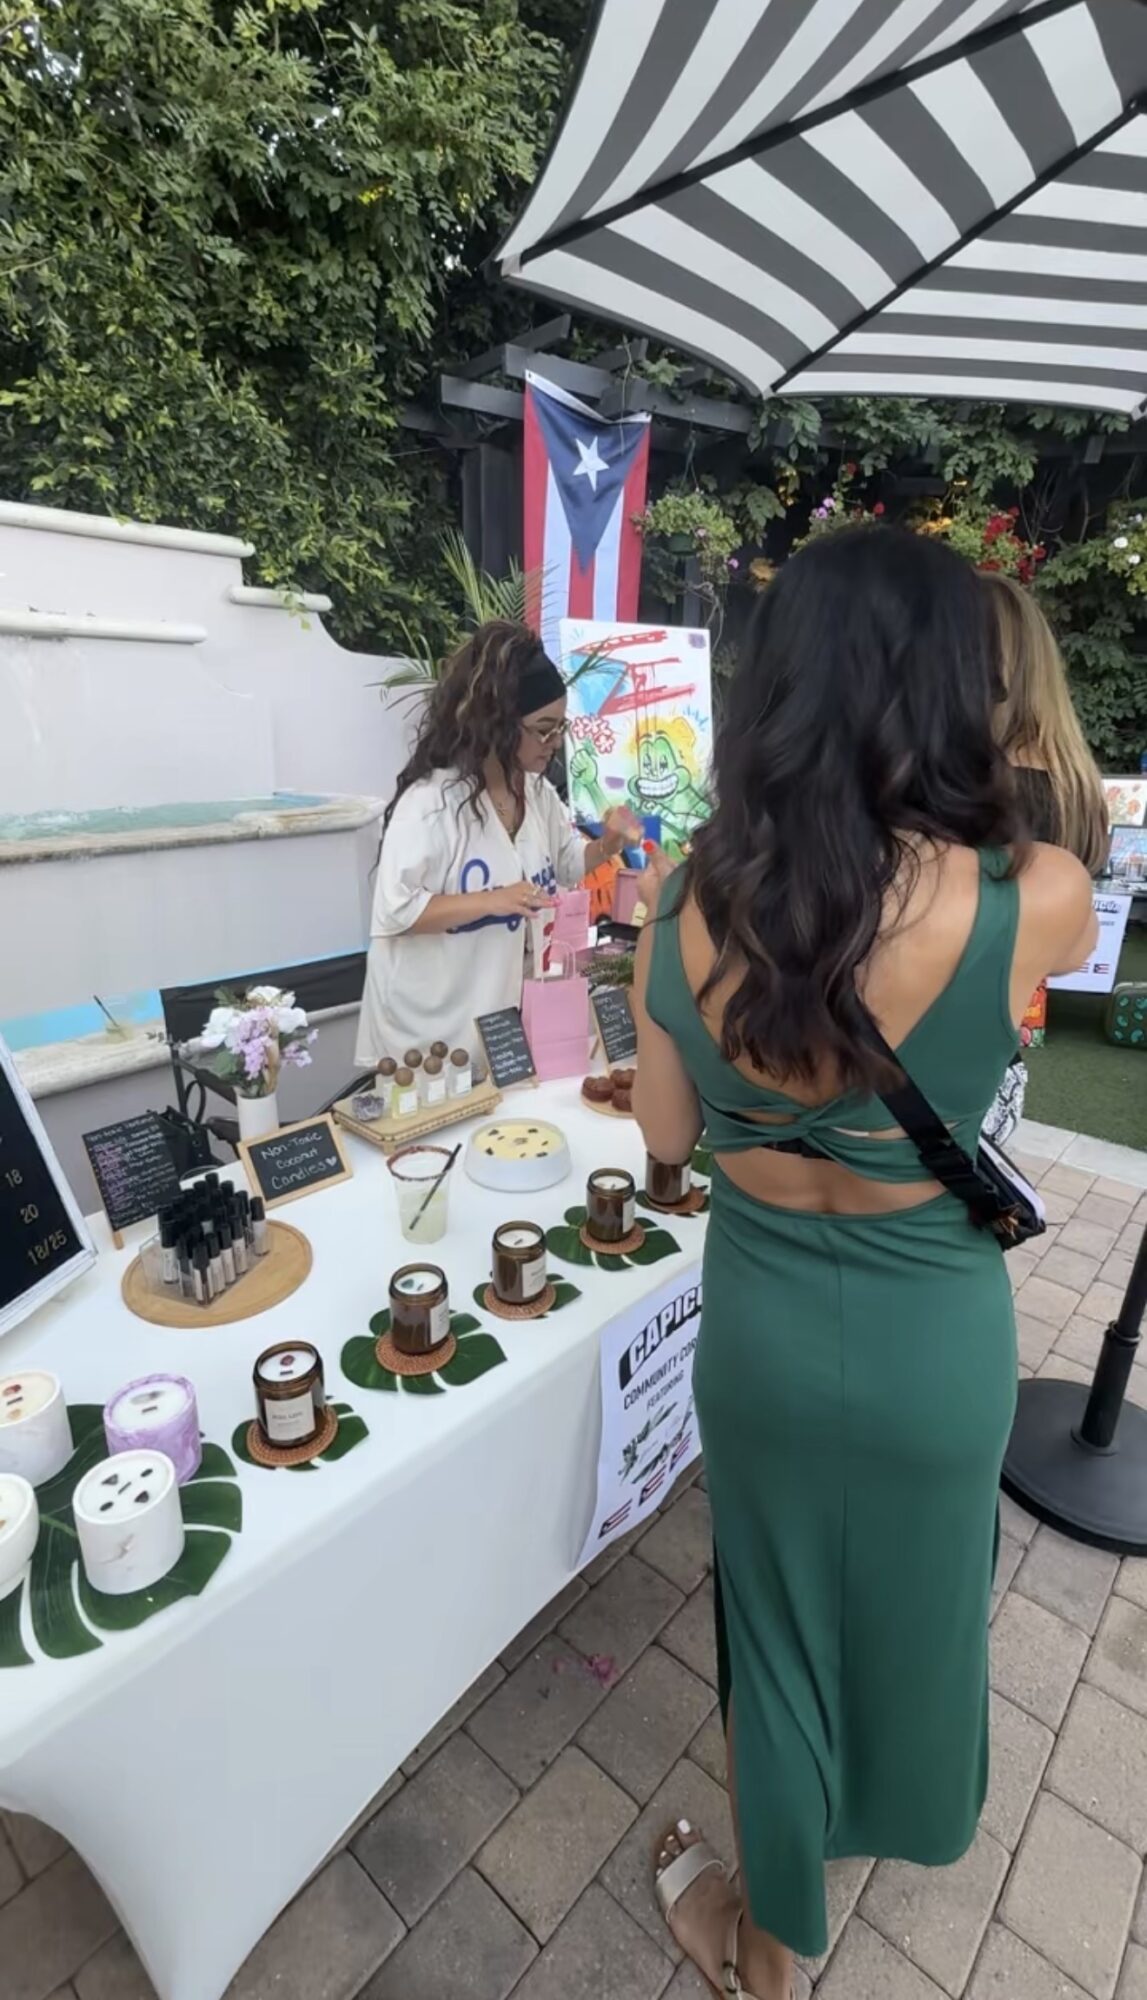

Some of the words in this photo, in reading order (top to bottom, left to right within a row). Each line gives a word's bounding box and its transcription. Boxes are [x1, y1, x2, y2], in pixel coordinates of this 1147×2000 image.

[276, 1146, 319, 1169] Coconut
[5, 1168, 24, 1188] 18
[271, 1160, 328, 1190] Candles
[20, 1203, 40, 1225] 20
[27, 1229, 68, 1266] 18/25
[623, 1353, 681, 1411] COMMUNITY
[646, 1369, 685, 1412] FEATURING
